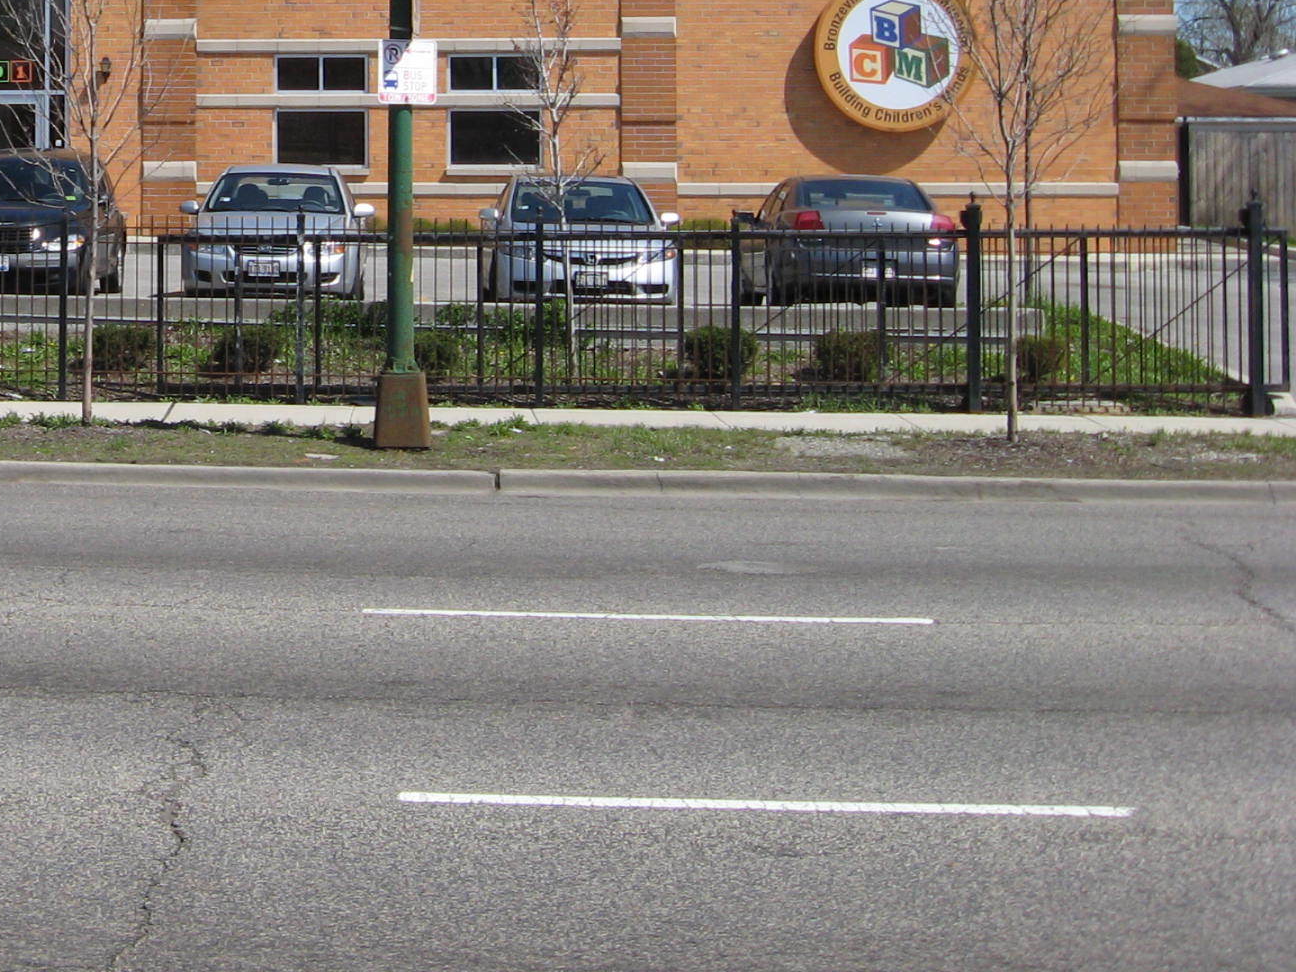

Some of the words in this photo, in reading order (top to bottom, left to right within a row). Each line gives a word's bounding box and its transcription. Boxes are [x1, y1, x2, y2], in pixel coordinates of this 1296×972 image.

[874, 15, 898, 42] B
[403, 70, 423, 80] BUS
[853, 53, 878, 78] C
[897, 51, 923, 81] M
[403, 81, 427, 91] STOP
[829, 71, 872, 117] Building
[875, 101, 942, 123] Children's
